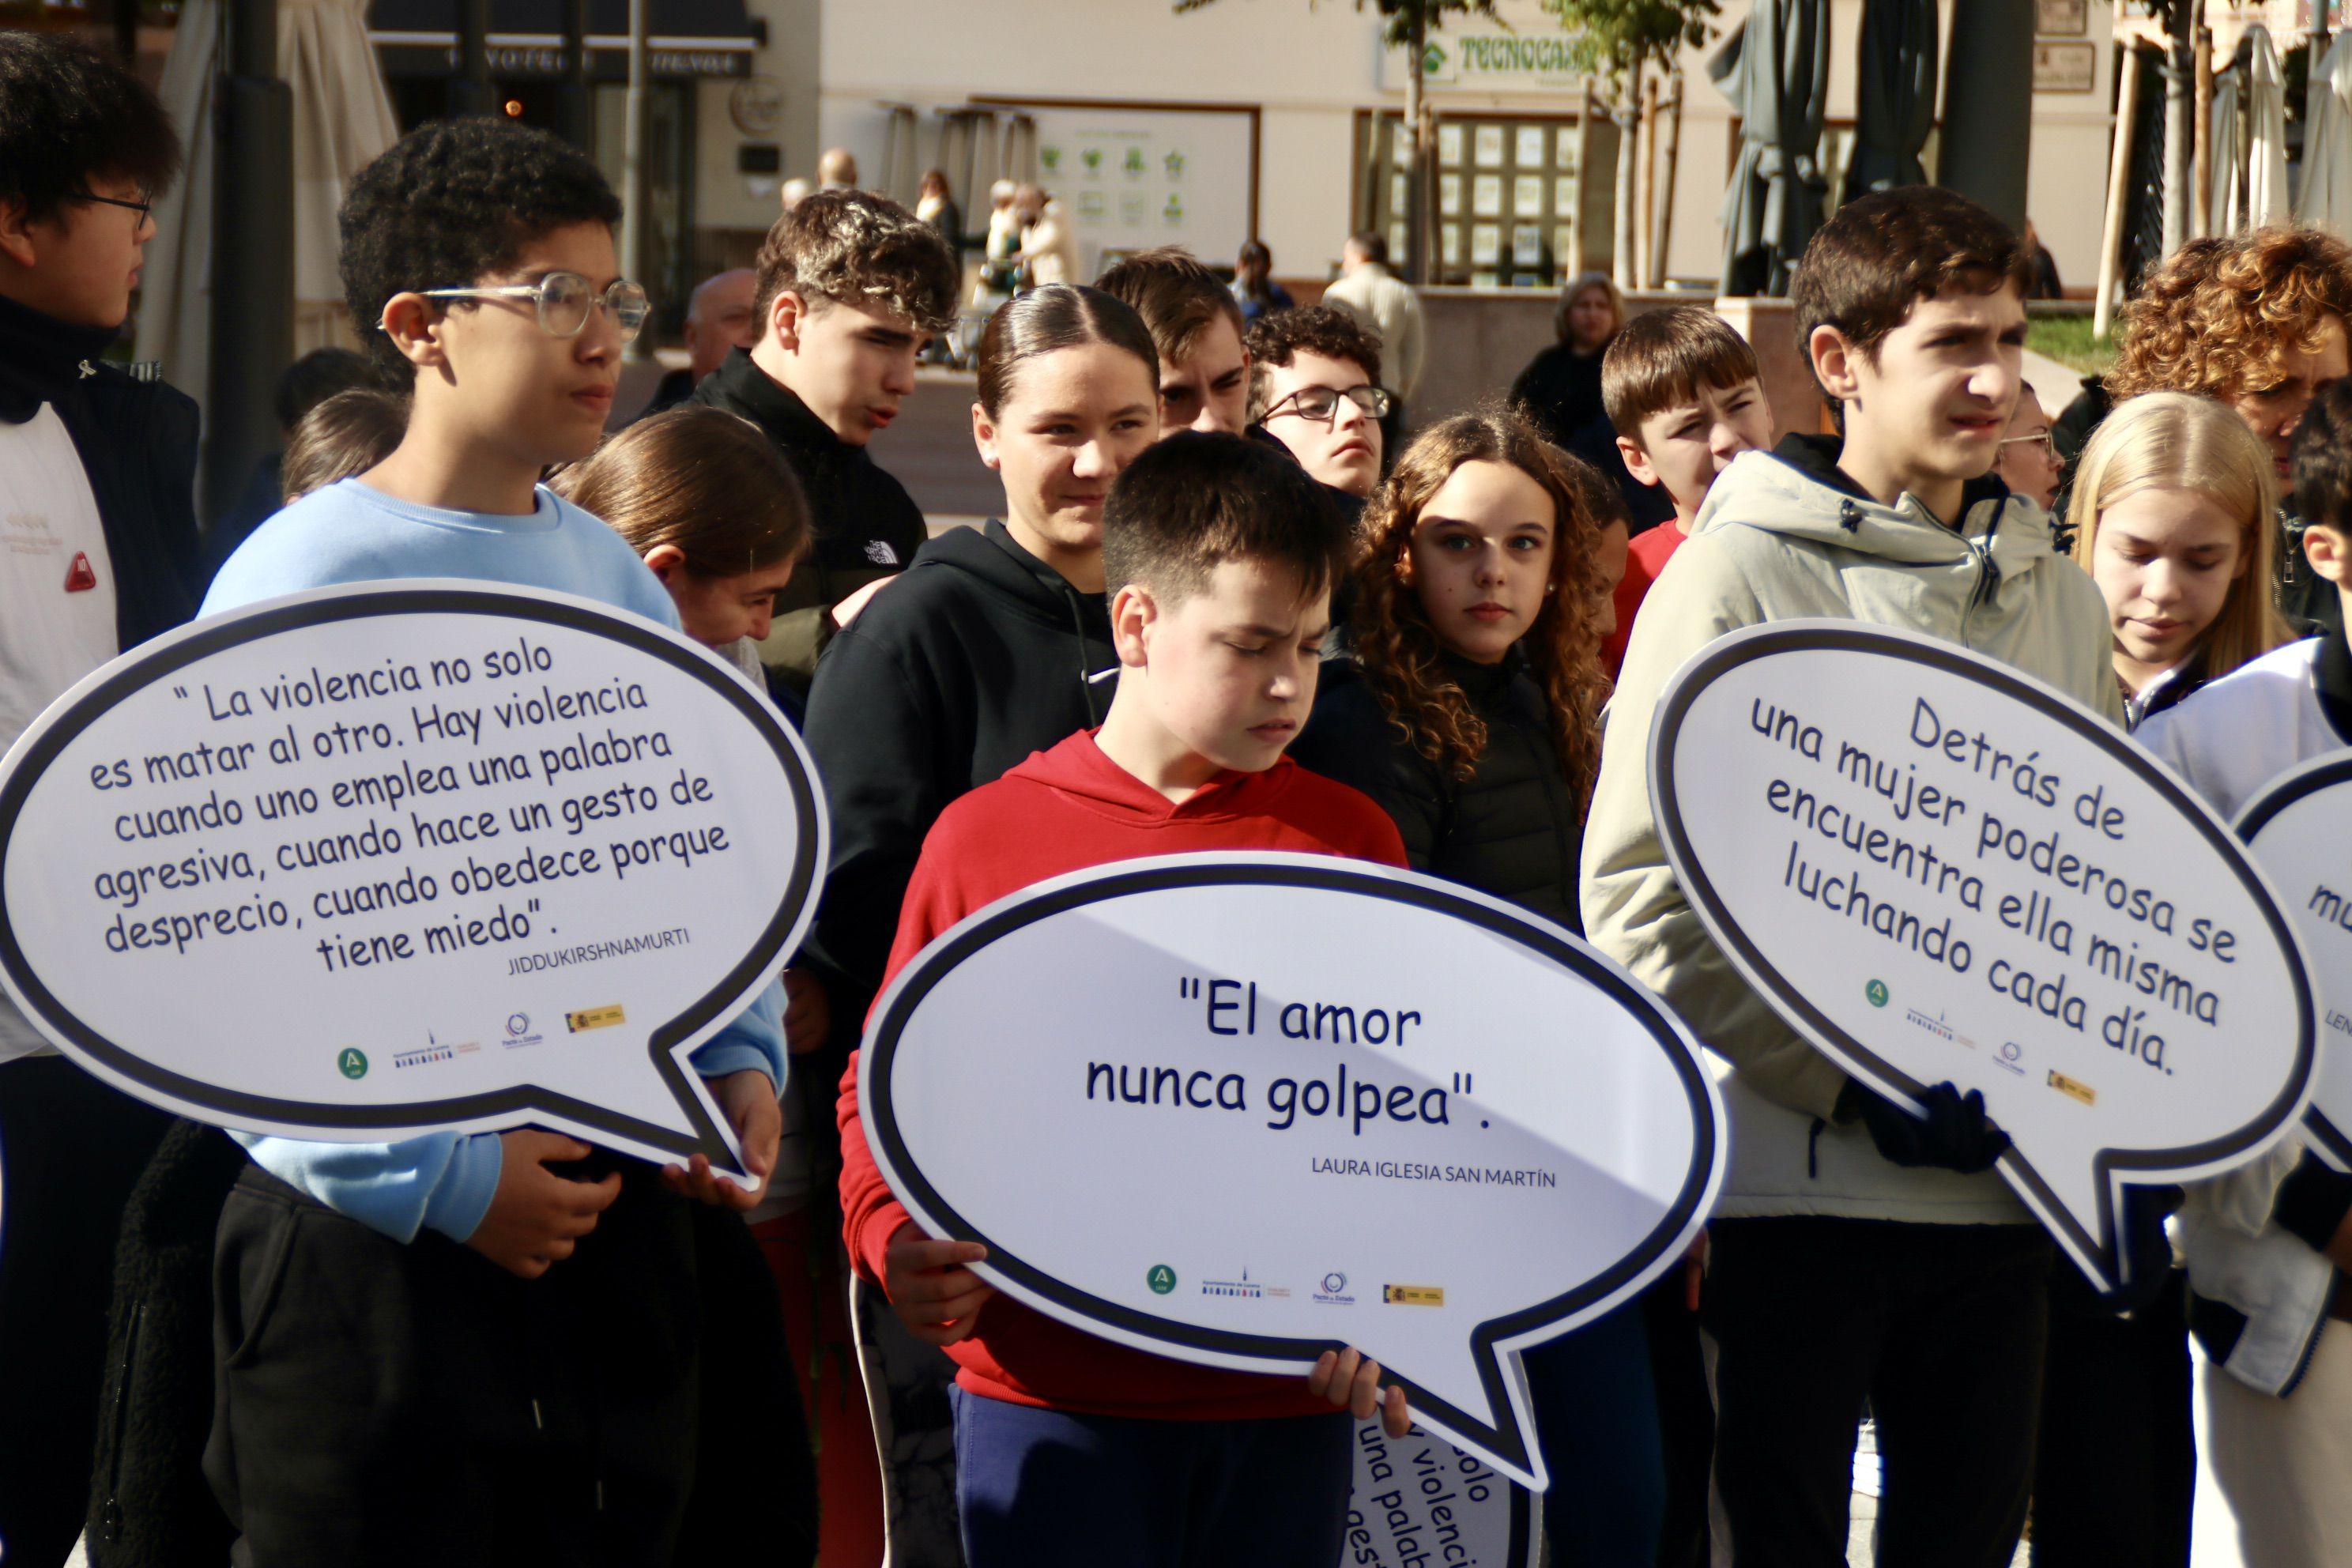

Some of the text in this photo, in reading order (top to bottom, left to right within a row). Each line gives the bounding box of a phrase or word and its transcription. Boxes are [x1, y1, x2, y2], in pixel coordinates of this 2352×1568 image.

[1459, 36, 1590, 70] TECNOCAS
[203, 684, 253, 722] La
[259, 665, 422, 711] violencia
[429, 658, 472, 687] no
[483, 636, 552, 680] solo
[90, 677, 648, 791] es matar al otro. Hay violencia
[1909, 696, 2125, 841] Detrás de
[115, 728, 673, 842] cuando uno emplea una palabra
[1751, 697, 2237, 964] una mujer poderosa se
[94, 767, 714, 909] agresiva, cuando hace un gesto de
[104, 826, 730, 956] desprecio, cuando obedece porque
[1766, 778, 2220, 1027] encuentra ella misma
[315, 933, 415, 973] tiene
[508, 927, 690, 976] JIDDUKIRSHNAMURTI
[1784, 838, 2173, 1076] luchando cada día.
[1179, 976, 1422, 1047] "El amor
[1086, 1061, 1247, 1112] nunca
[1312, 1157, 1555, 1188] LAURA IGLESIA SAN MARTÍN
[1358, 1424, 1393, 1483] una
